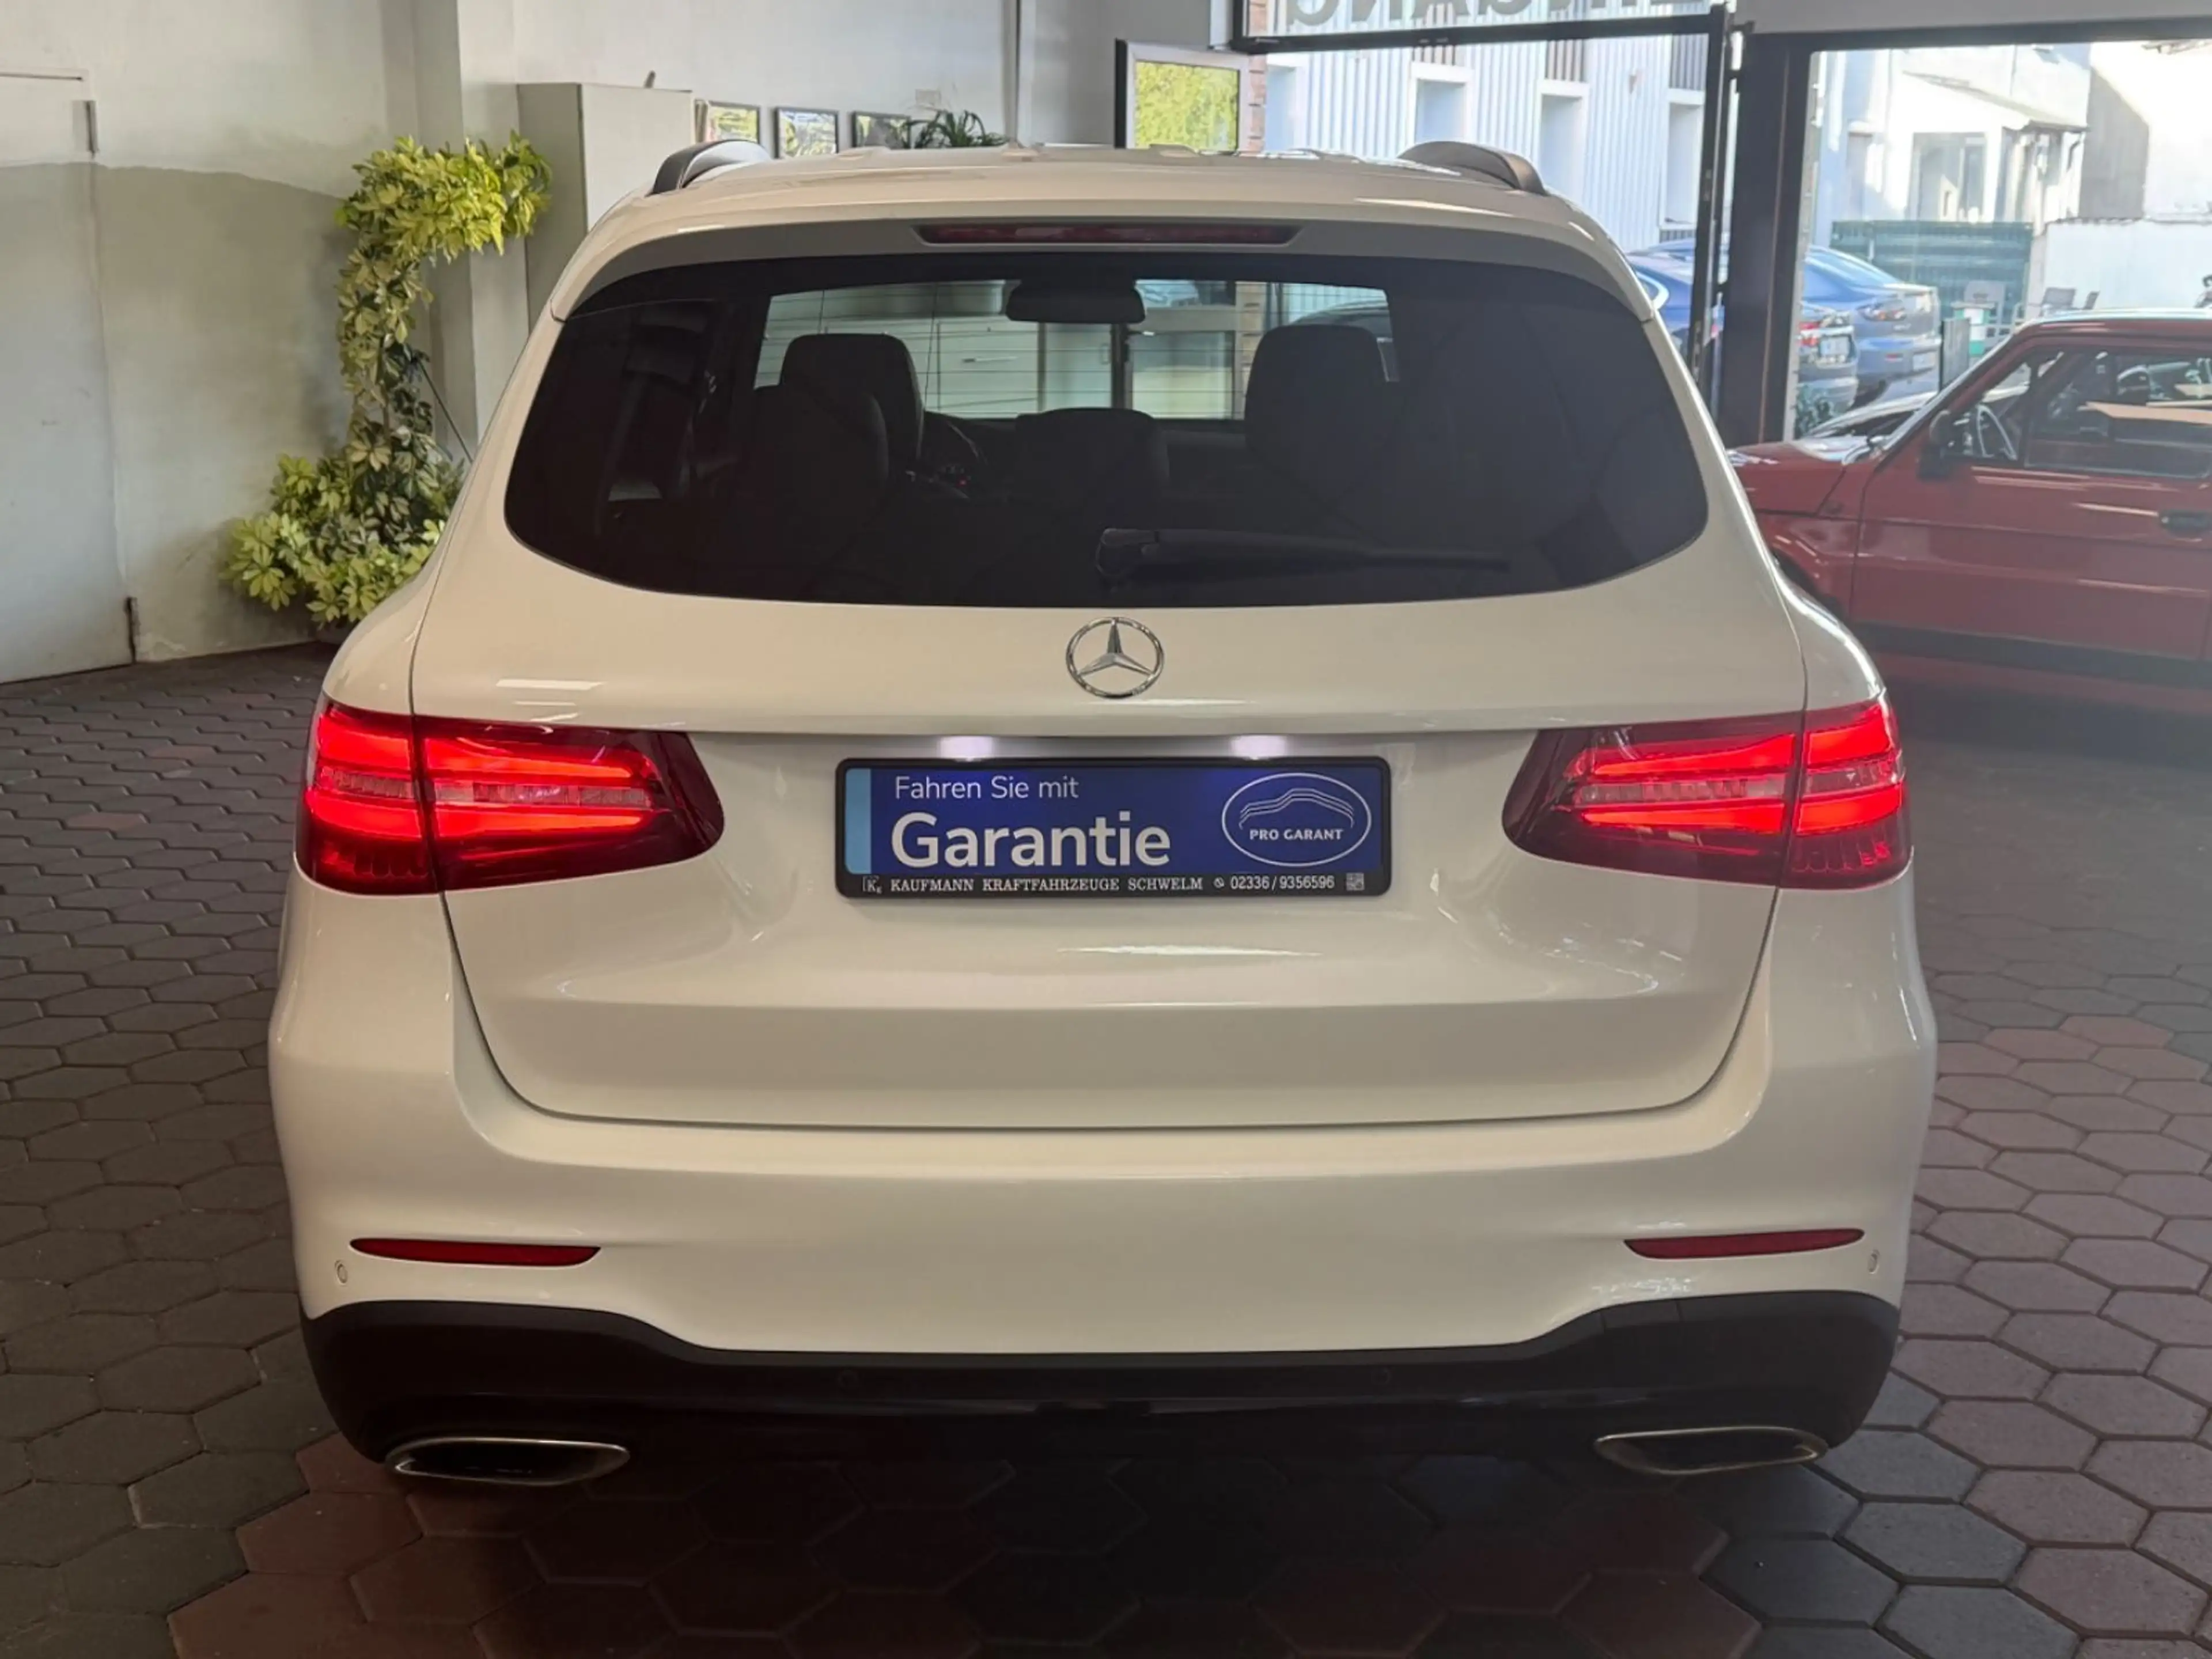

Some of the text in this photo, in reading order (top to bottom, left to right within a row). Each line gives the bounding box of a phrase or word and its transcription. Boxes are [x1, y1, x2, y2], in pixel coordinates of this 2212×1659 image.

[895, 775, 1079, 800] Fahren Sie mit
[891, 810, 1171, 868] Garantie
[1249, 828, 1344, 841] PRO GARANT
[891, 878, 974, 892] KAUFMANN
[982, 877, 1120, 892] KRAFTFAHRZEUGE
[1128, 877, 1203, 891] SCHWELM
